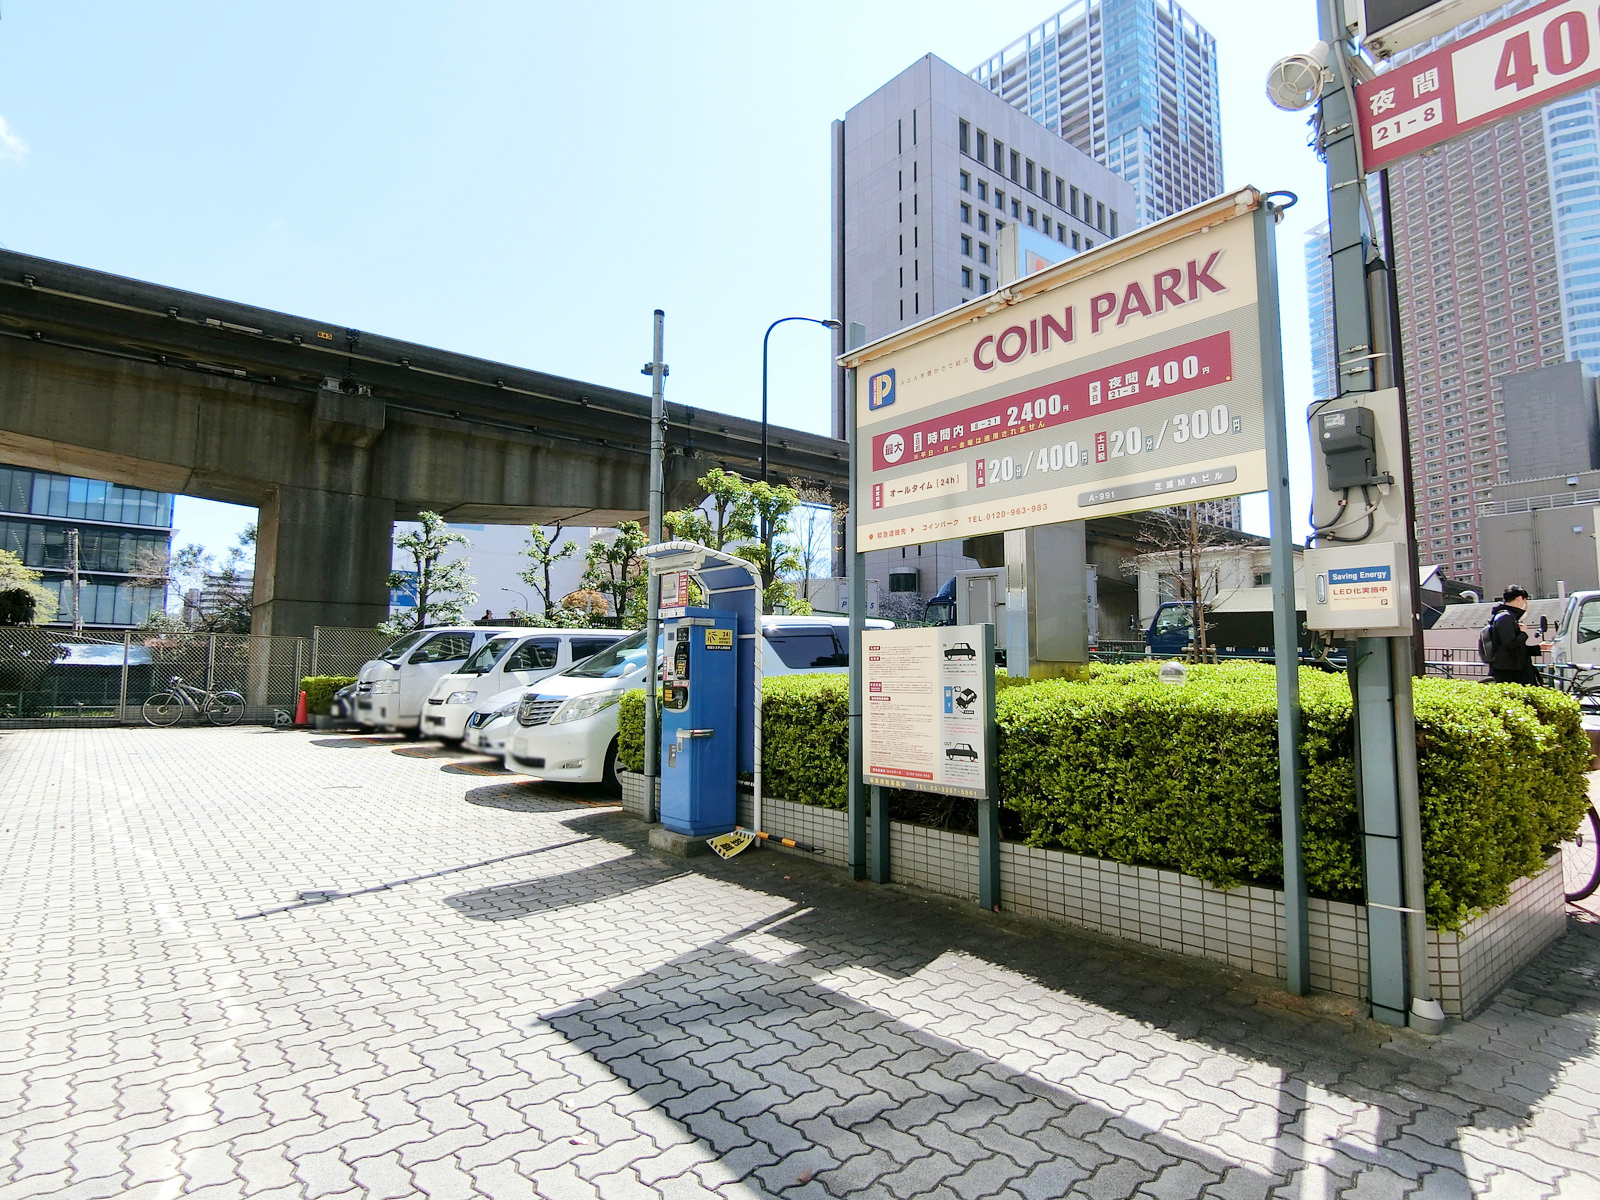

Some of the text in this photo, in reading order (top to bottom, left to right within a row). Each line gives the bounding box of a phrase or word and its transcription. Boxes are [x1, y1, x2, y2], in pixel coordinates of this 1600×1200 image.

[1494, 5, 1600, 92] 40
[1370, 67, 1439, 116] 夜間
[1377, 107, 1435, 142] 21-8
[973, 248, 1227, 372] COIN PARK
[1108, 371, 1139, 390] 夜間
[927, 424, 964, 445] 時間内
[884, 441, 903, 456] 最大
[1088, 491, 1115, 503] A-991
[922, 519, 959, 532] コインパーク
[1332, 571, 1387, 581] Saving Energy
[1333, 586, 1387, 595] LED化実施中
